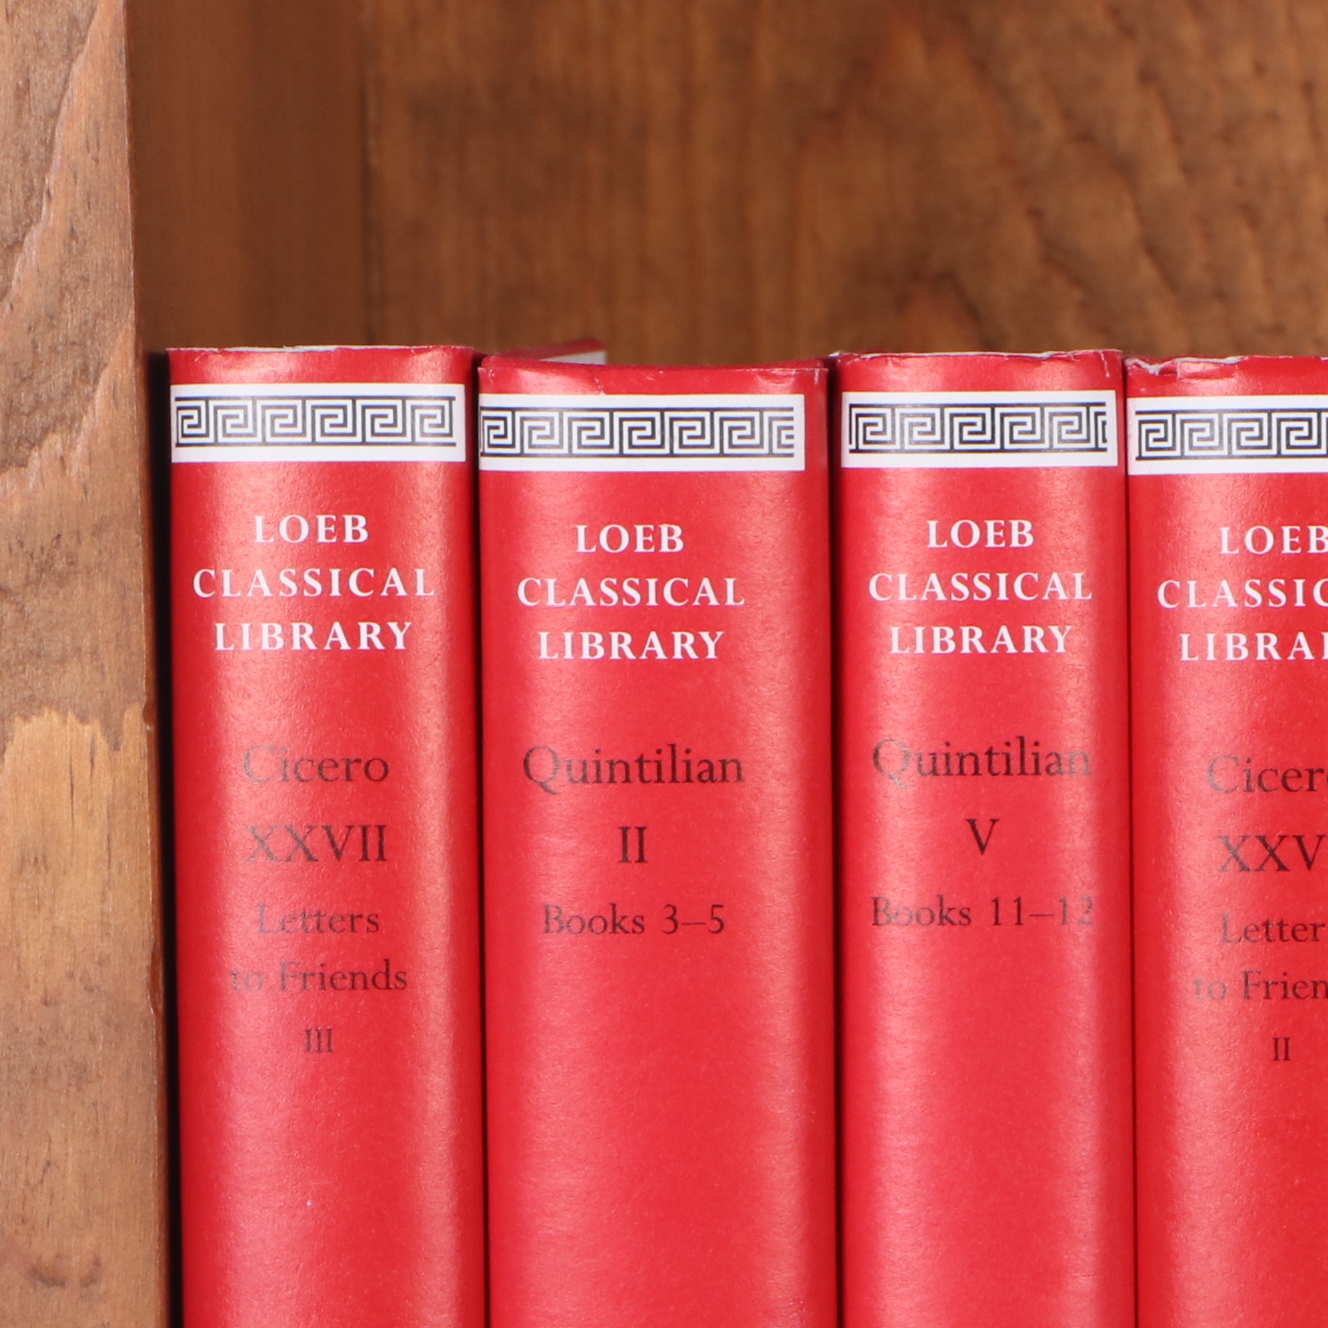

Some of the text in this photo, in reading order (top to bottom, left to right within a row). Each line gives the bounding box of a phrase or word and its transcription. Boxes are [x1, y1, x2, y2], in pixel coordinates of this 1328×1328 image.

[252, 514, 370, 544] LOEB
[574, 524, 685, 554] LOEB
[926, 518, 1035, 549] LOEB
[192, 566, 436, 599] CLASSICAL
[516, 576, 745, 607] CLASSICAL
[867, 571, 1093, 603] CLASSICAL
[213, 621, 413, 652] LIBRARY
[537, 630, 725, 660] LIBRARY
[889, 624, 1073, 656] LIBRARY
[241, 744, 391, 784] Cicero
[522, 744, 745, 796] Quintilian
[871, 736, 1092, 788] Quintilian
[244, 823, 388, 863] XXVII
[617, 825, 647, 864] II
[964, 817, 1000, 856] V
[254, 903, 381, 935] Letters
[542, 903, 646, 936] Books
[869, 895, 973, 927] Books
[229, 958, 409, 993] to Friends
[1193, 974, 1228, 1002] to
[302, 1028, 334, 1054] III
[1271, 1036, 1291, 1062] II
